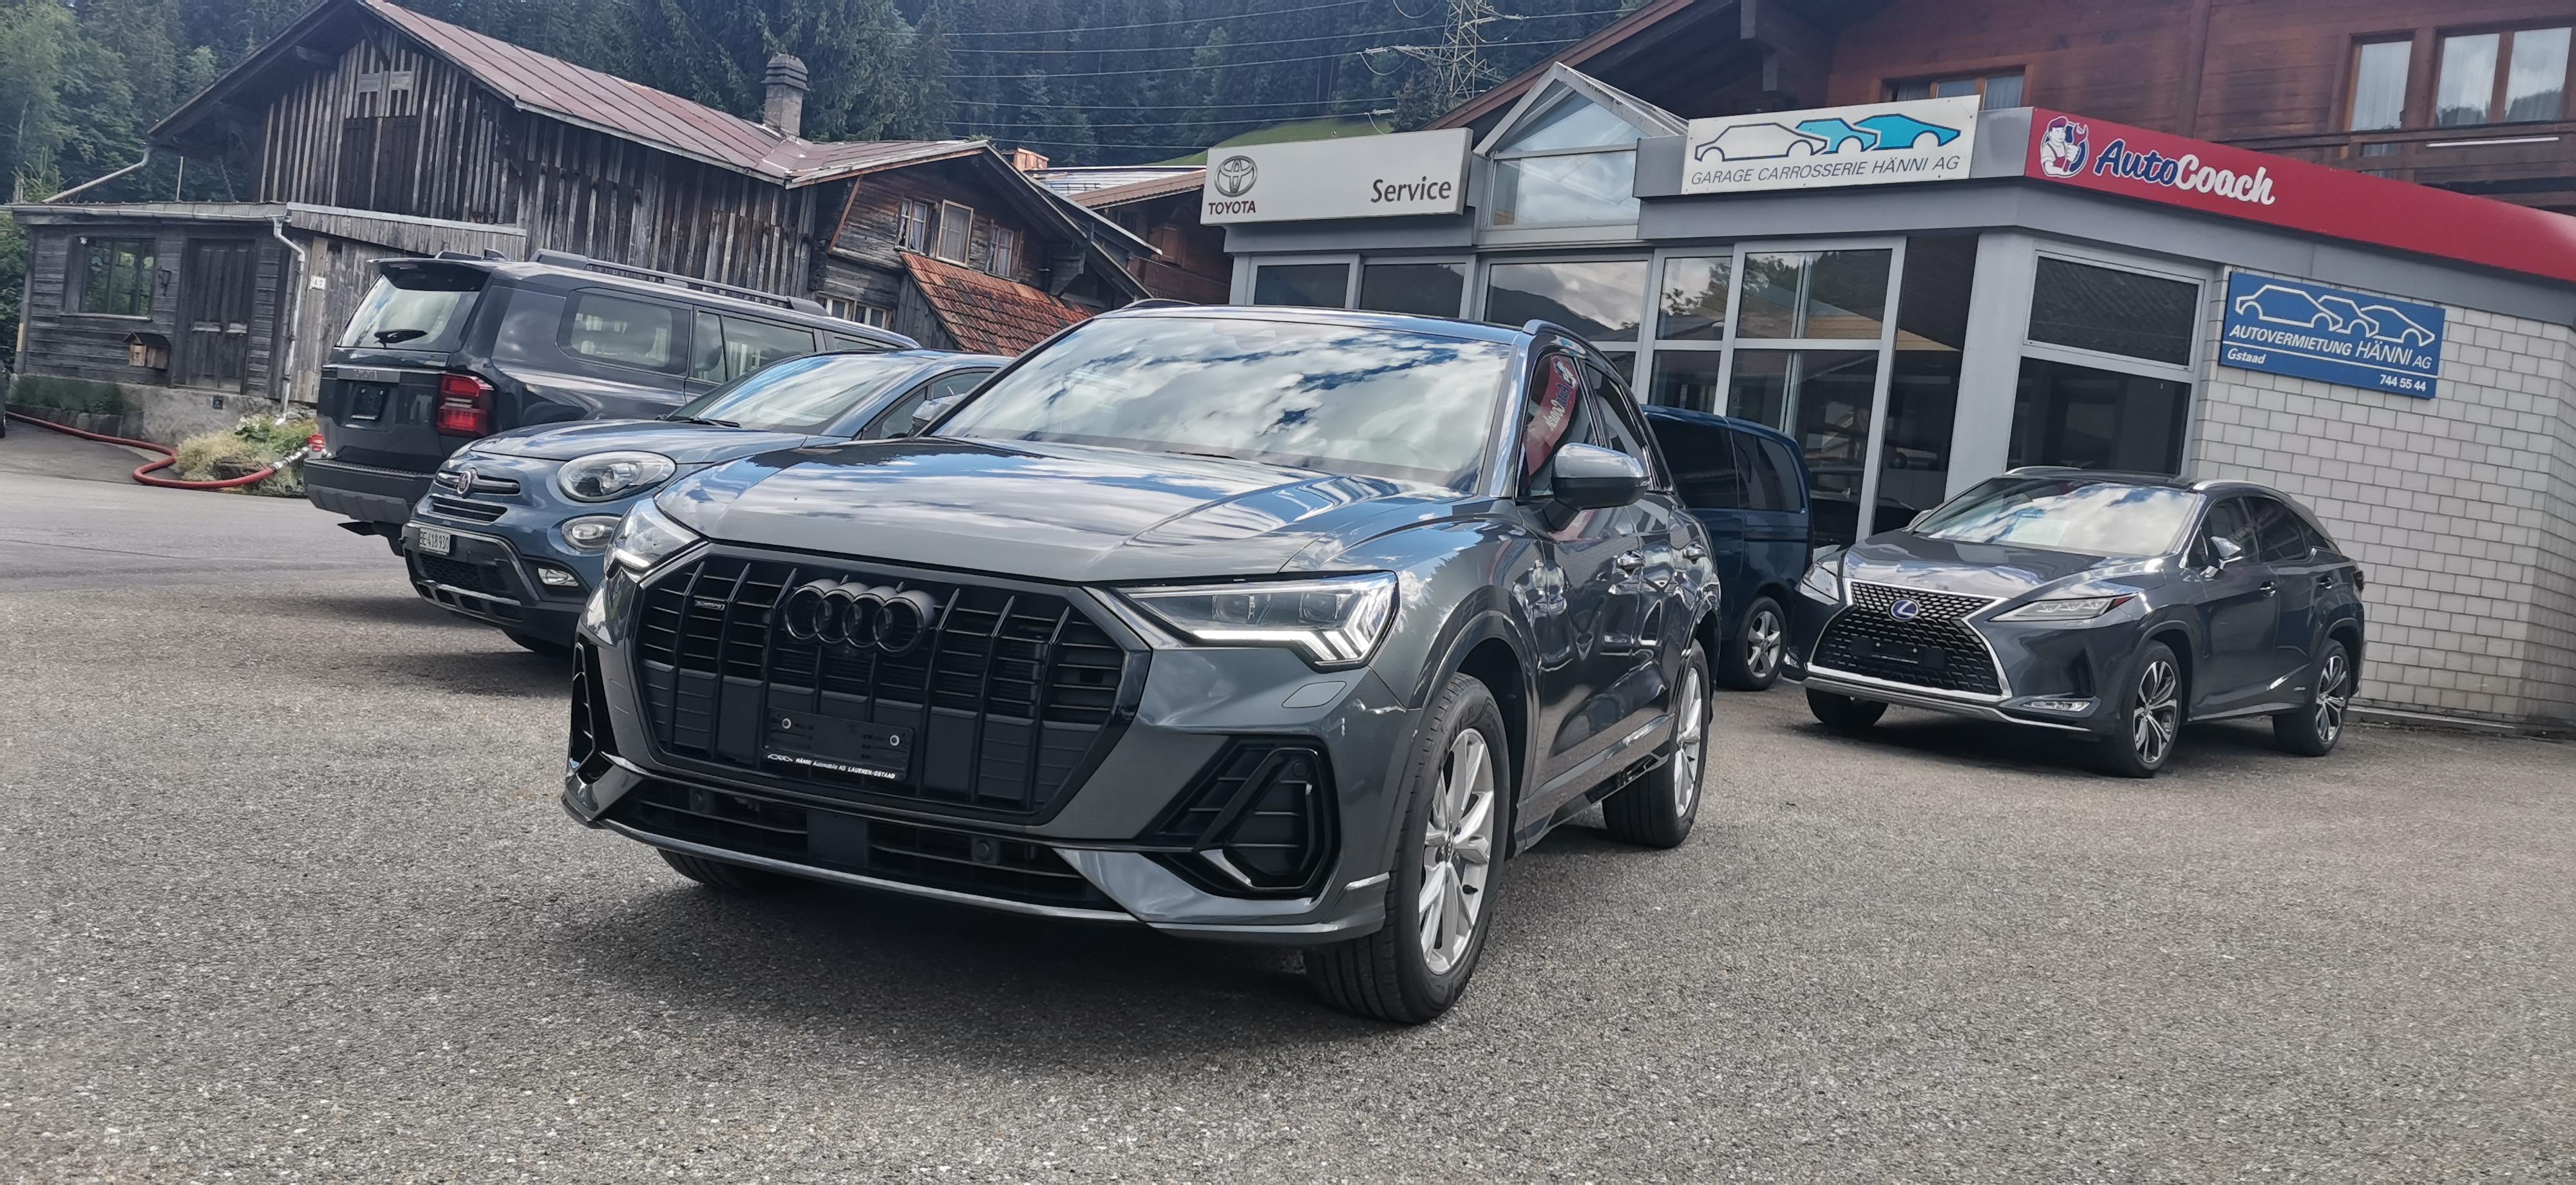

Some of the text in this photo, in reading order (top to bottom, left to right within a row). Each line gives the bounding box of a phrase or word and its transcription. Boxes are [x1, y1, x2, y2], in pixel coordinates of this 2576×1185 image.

[1691, 155, 1960, 185] GARAGE CARROSSERIE HÄNNI AG
[2094, 138, 2275, 205] AutoCoach
[1371, 176, 1452, 204] Service
[1208, 200, 1256, 215] TOYOTA
[2227, 348, 2266, 365] Gstaad
[2229, 324, 2432, 369] AUTOVERMIETUNG HÄNNI AG
[2379, 374, 2427, 392] 744 55 44
[848, 766, 895, 779] LAUENEN/GSTAAD
